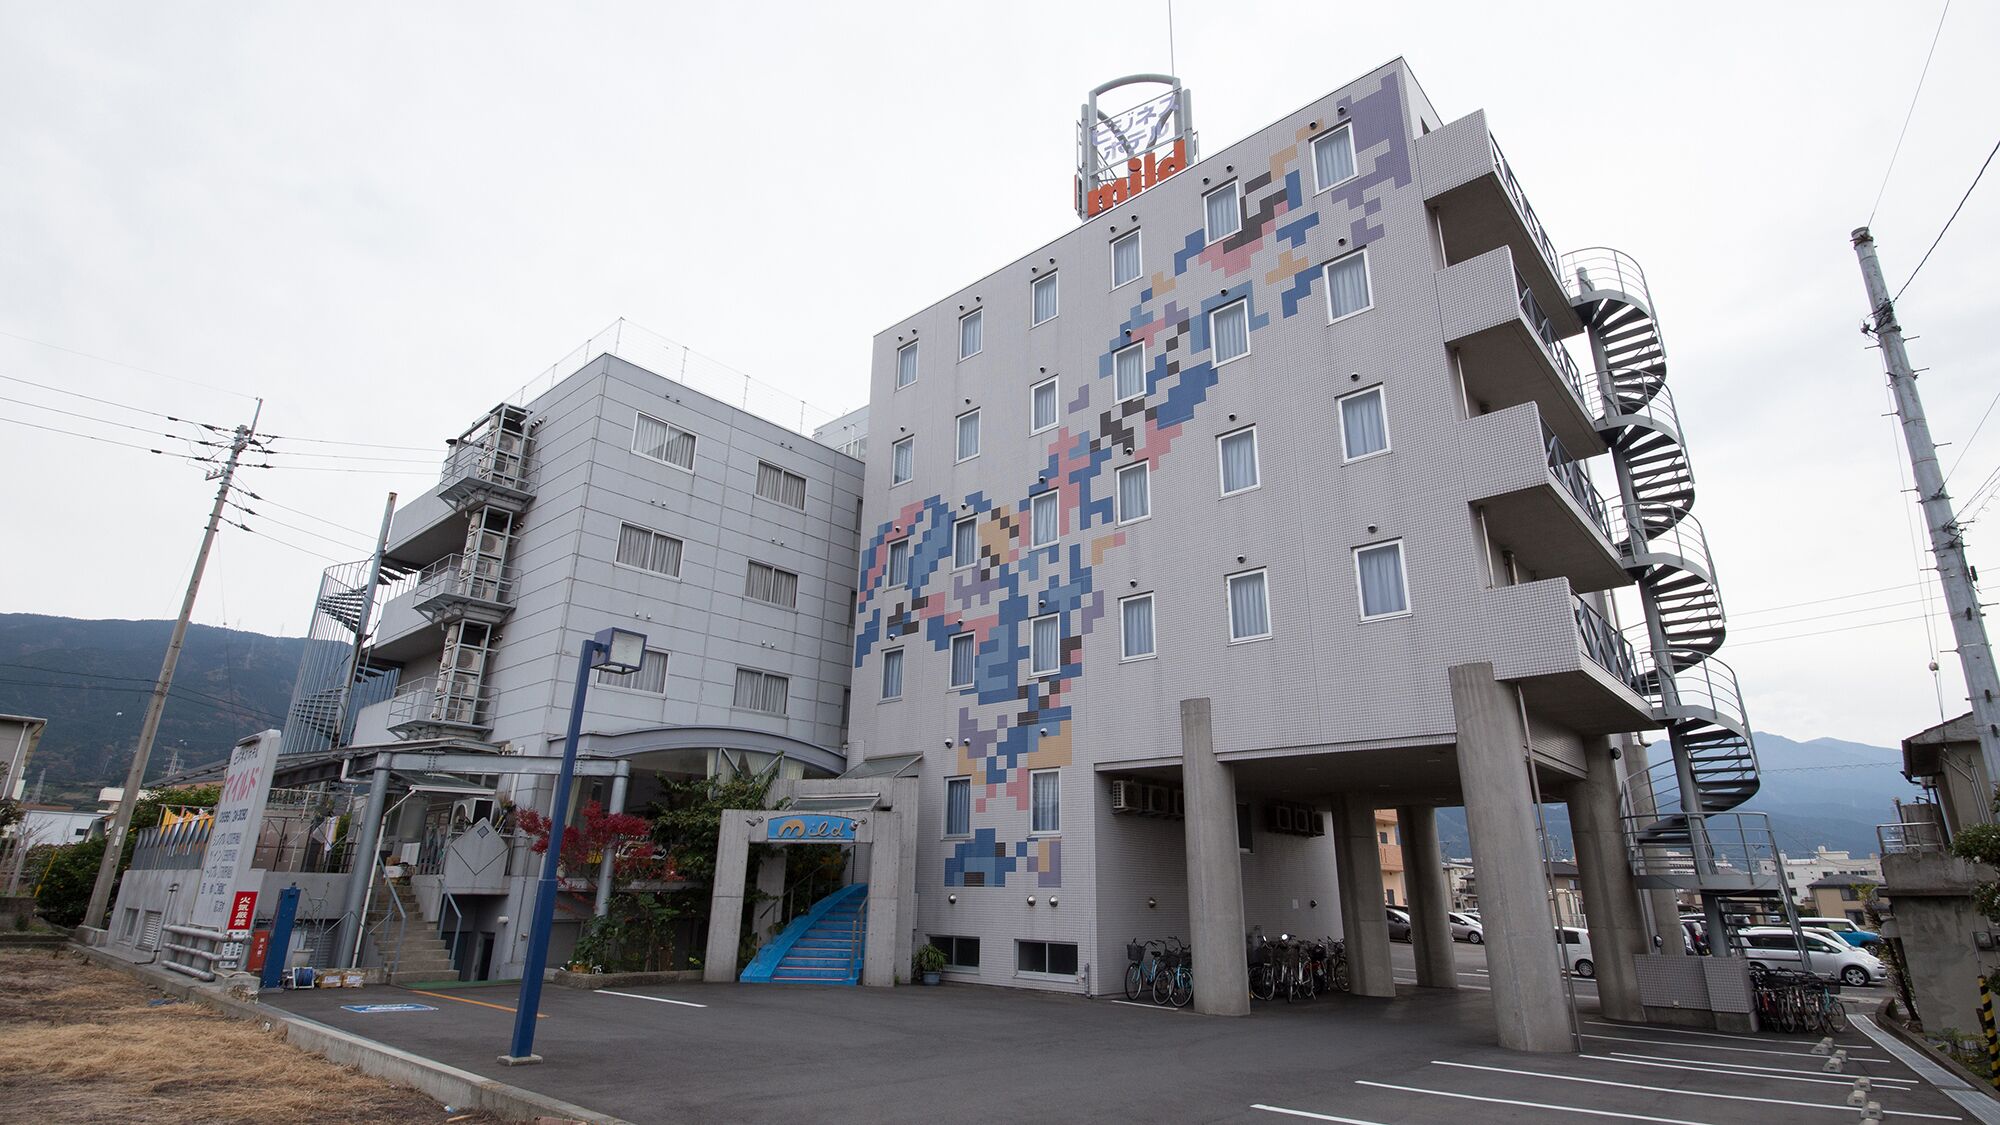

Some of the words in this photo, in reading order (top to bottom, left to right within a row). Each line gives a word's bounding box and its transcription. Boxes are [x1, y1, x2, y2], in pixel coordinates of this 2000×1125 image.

[1087, 138, 1186, 218] mild
[224, 766, 260, 802] マイルド
